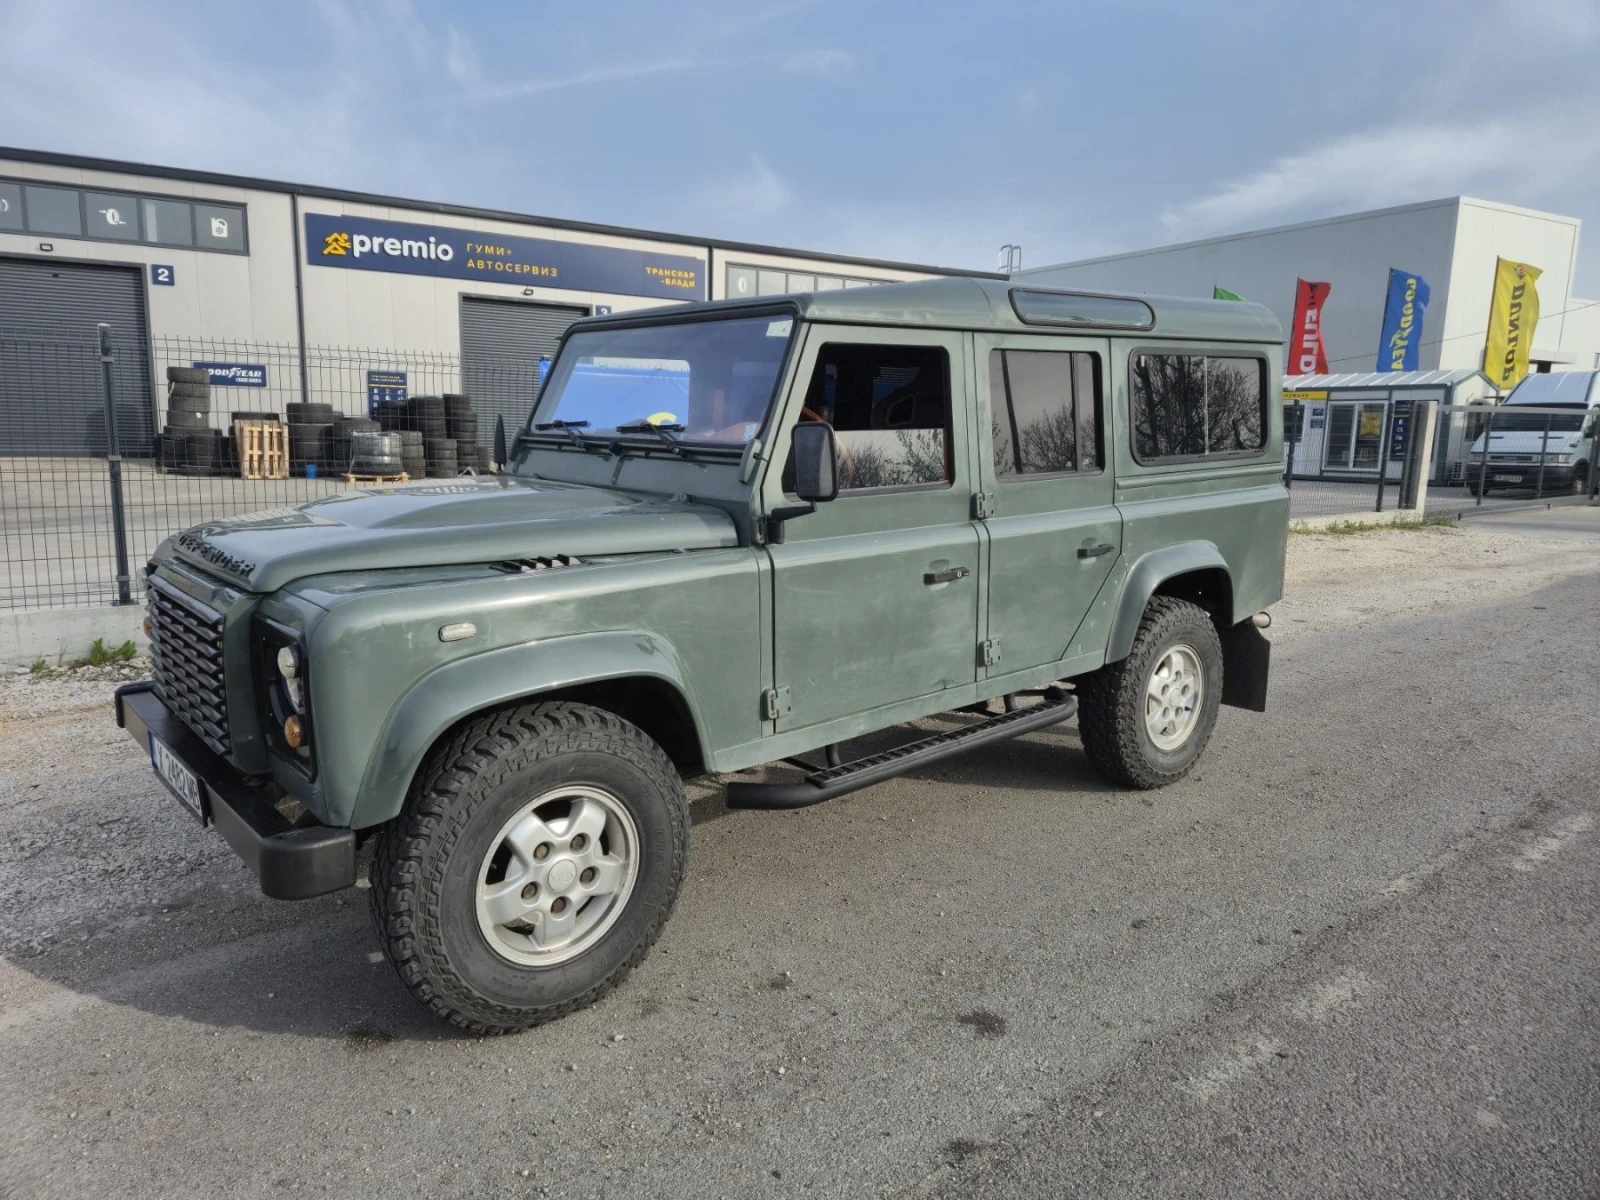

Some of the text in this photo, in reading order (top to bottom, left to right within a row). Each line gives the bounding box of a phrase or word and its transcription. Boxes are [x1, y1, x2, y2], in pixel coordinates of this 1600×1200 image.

[353, 234, 454, 262] premio
[466, 243, 513, 256] ГУМИ+
[157, 267, 170, 282] 2
[467, 259, 558, 277] АВТОСЕРВИЗ
[645, 266, 696, 279] ТРАНСКАР
[203, 367, 262, 379] OODYEAR
